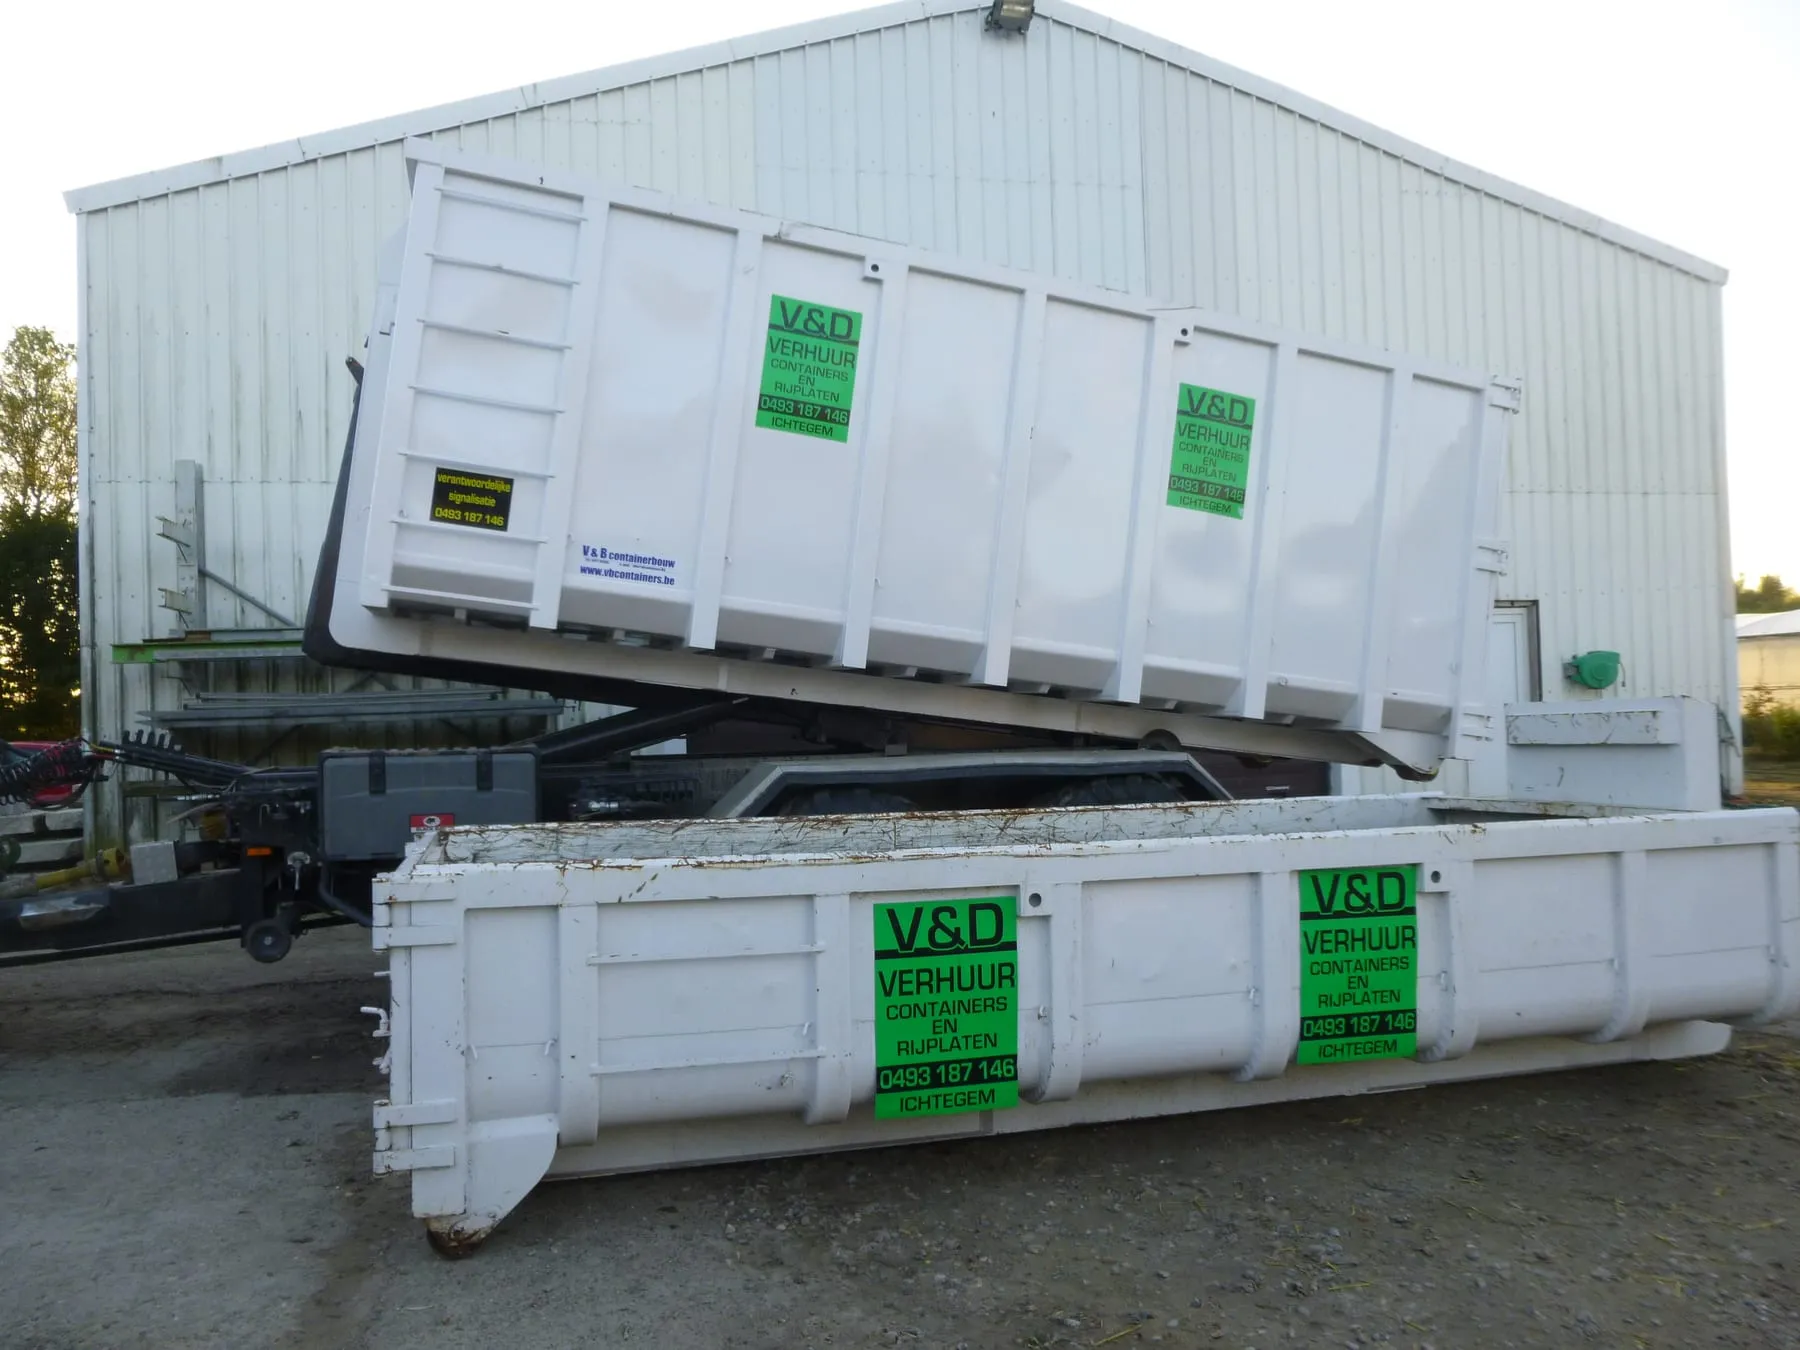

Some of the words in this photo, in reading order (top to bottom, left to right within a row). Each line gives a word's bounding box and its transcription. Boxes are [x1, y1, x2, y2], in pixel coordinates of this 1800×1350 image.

[780, 300, 853, 339] V&D
[769, 336, 856, 368] VERHUUR
[771, 358, 848, 382] CONTAINERS
[798, 375, 815, 387] EN
[774, 381, 840, 402] RIJPLATEN
[761, 397, 794, 413] 0493
[798, 403, 821, 418] 187
[825, 409, 848, 423] 146
[1187, 388, 1248, 424] V&D
[772, 416, 833, 436] ICHTEGEM
[1178, 422, 1250, 451] VERHUUR
[1179, 442, 1244, 463] CONTAINERS
[1203, 457, 1216, 467] EN
[437, 474, 511, 493] verantwoordelijke
[1182, 464, 1236, 482] RIJPLATEN
[1171, 477, 1199, 493] 0493
[1202, 482, 1221, 497] 187
[1179, 496, 1232, 513] ICHTEGEM
[435, 507, 461, 520] 0493
[464, 512, 482, 523] 187
[485, 515, 504, 526] 146
[583, 545, 590, 556] V
[591, 548, 598, 557] &
[600, 548, 607, 558] B
[609, 552, 676, 568] containerbouw
[580, 566, 675, 585] www.vbcontainers.be
[1311, 871, 1406, 914] V&D
[886, 903, 1004, 952] V&D
[1304, 925, 1416, 955] VERHUUR
[1310, 956, 1409, 975] CONTAINERS
[878, 962, 1016, 997] VERHUUR
[1348, 975, 1369, 990] EN
[886, 996, 1007, 1020] CONTAINERS
[1318, 989, 1401, 1008] RIJPLATEN
[932, 1018, 957, 1035] EN
[1304, 1018, 1345, 1037] 0493
[1350, 1015, 1380, 1034] 187
[1385, 1012, 1415, 1030] 146
[897, 1032, 998, 1056] RIJPLATEN
[1318, 1039, 1398, 1058] ICHTEGEM
[880, 1066, 931, 1089] 0493
[936, 1062, 973, 1084] 187
[979, 1058, 1015, 1080] 146
[900, 1088, 996, 1112] ICHTEGEM
